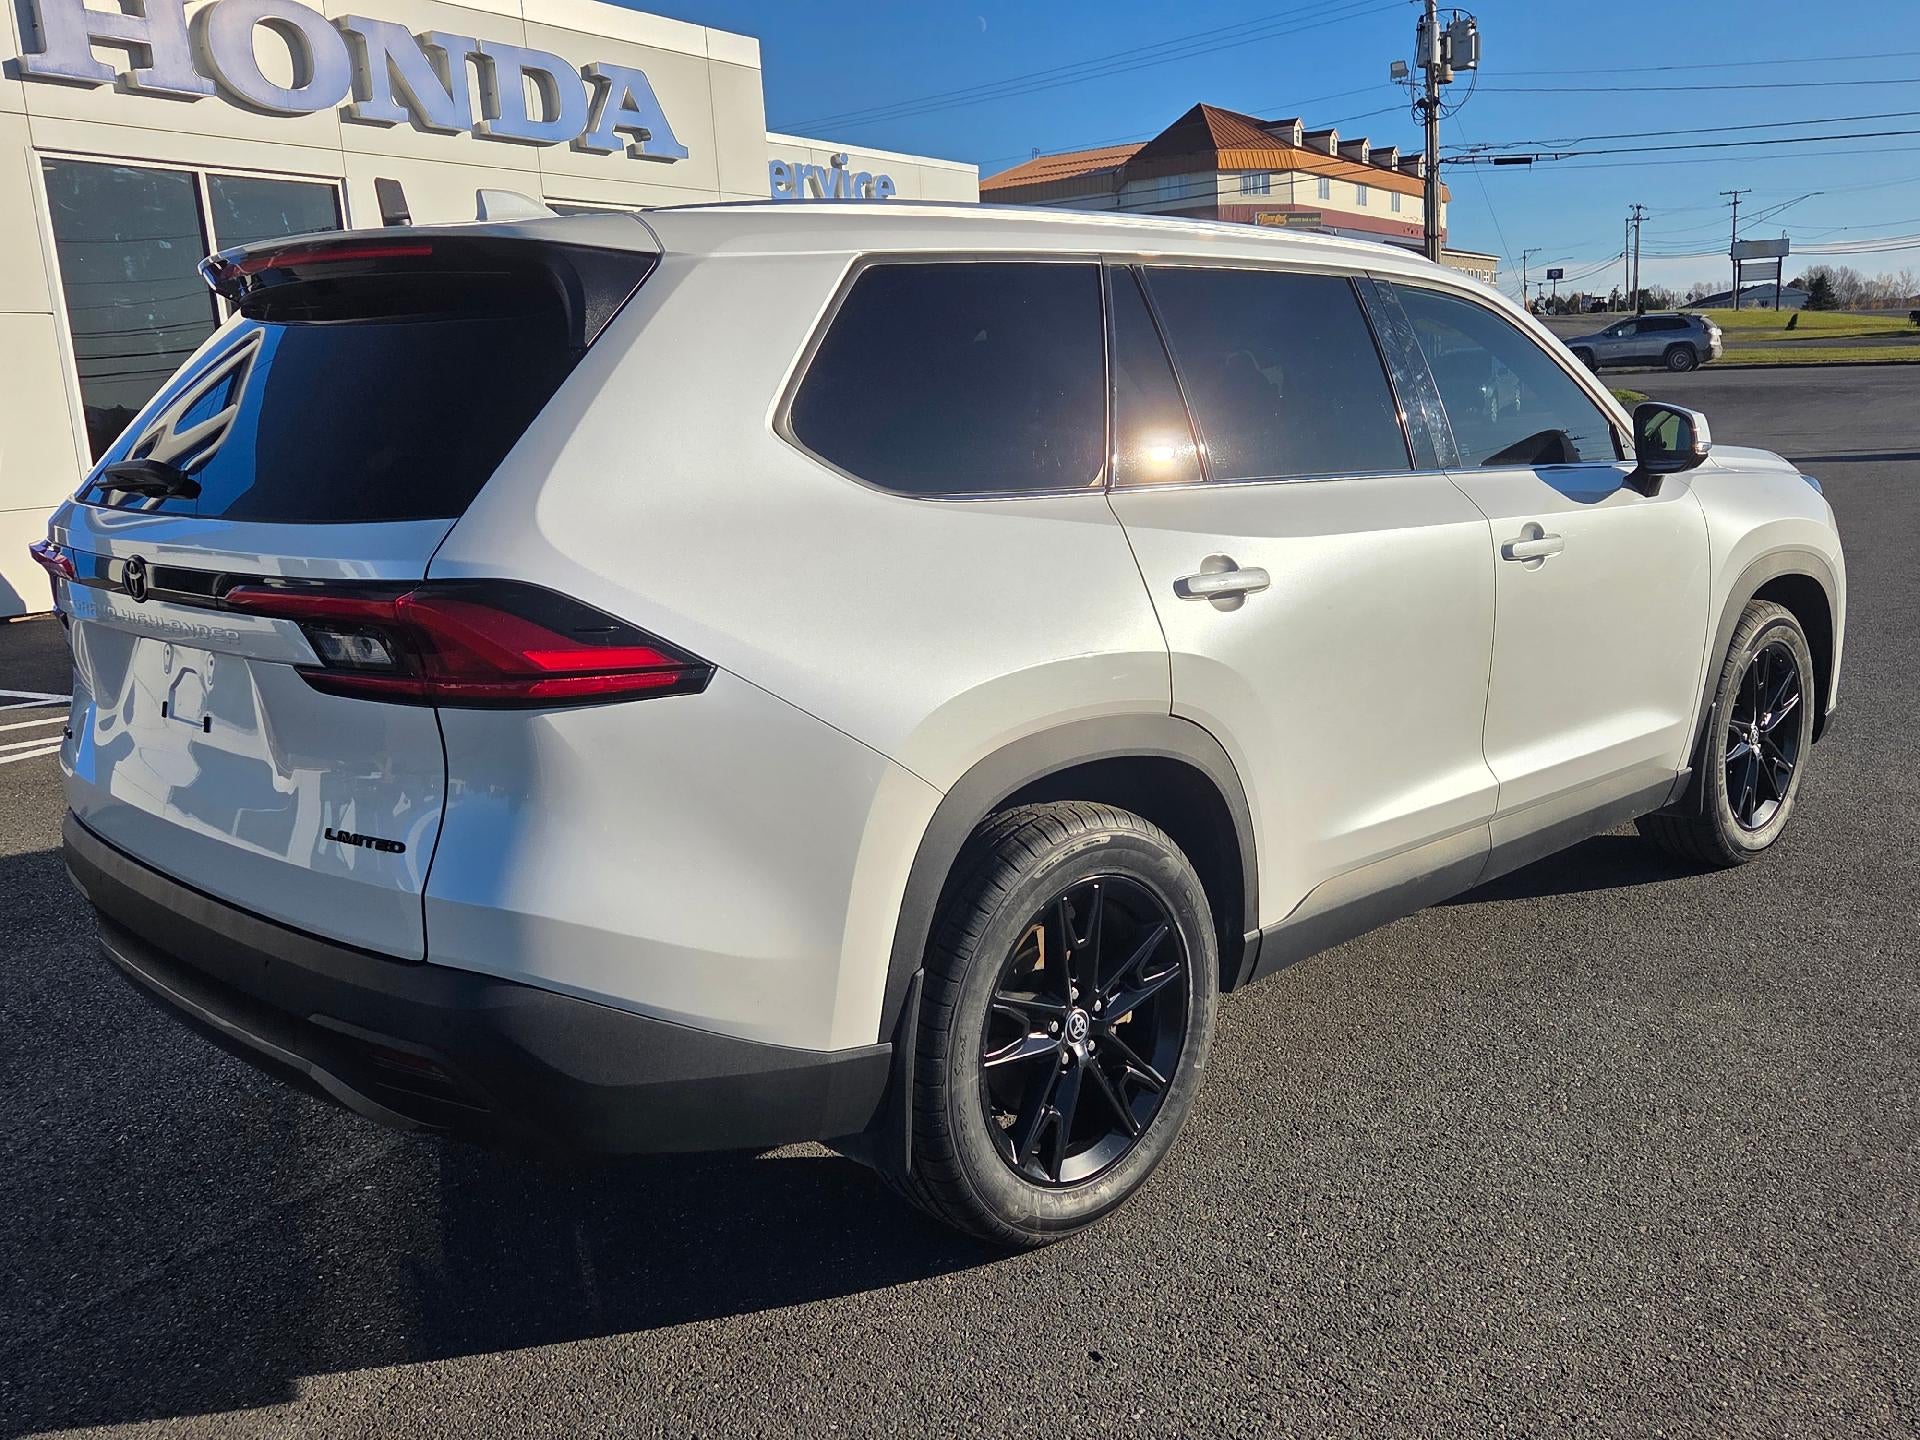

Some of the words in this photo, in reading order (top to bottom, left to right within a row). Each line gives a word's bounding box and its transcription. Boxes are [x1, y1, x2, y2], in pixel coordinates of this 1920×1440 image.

[4, 0, 688, 162] HONDA
[768, 152, 896, 199] ervice
[120, 608, 241, 646] HIGHLANDER
[324, 827, 407, 854] LIMITED
